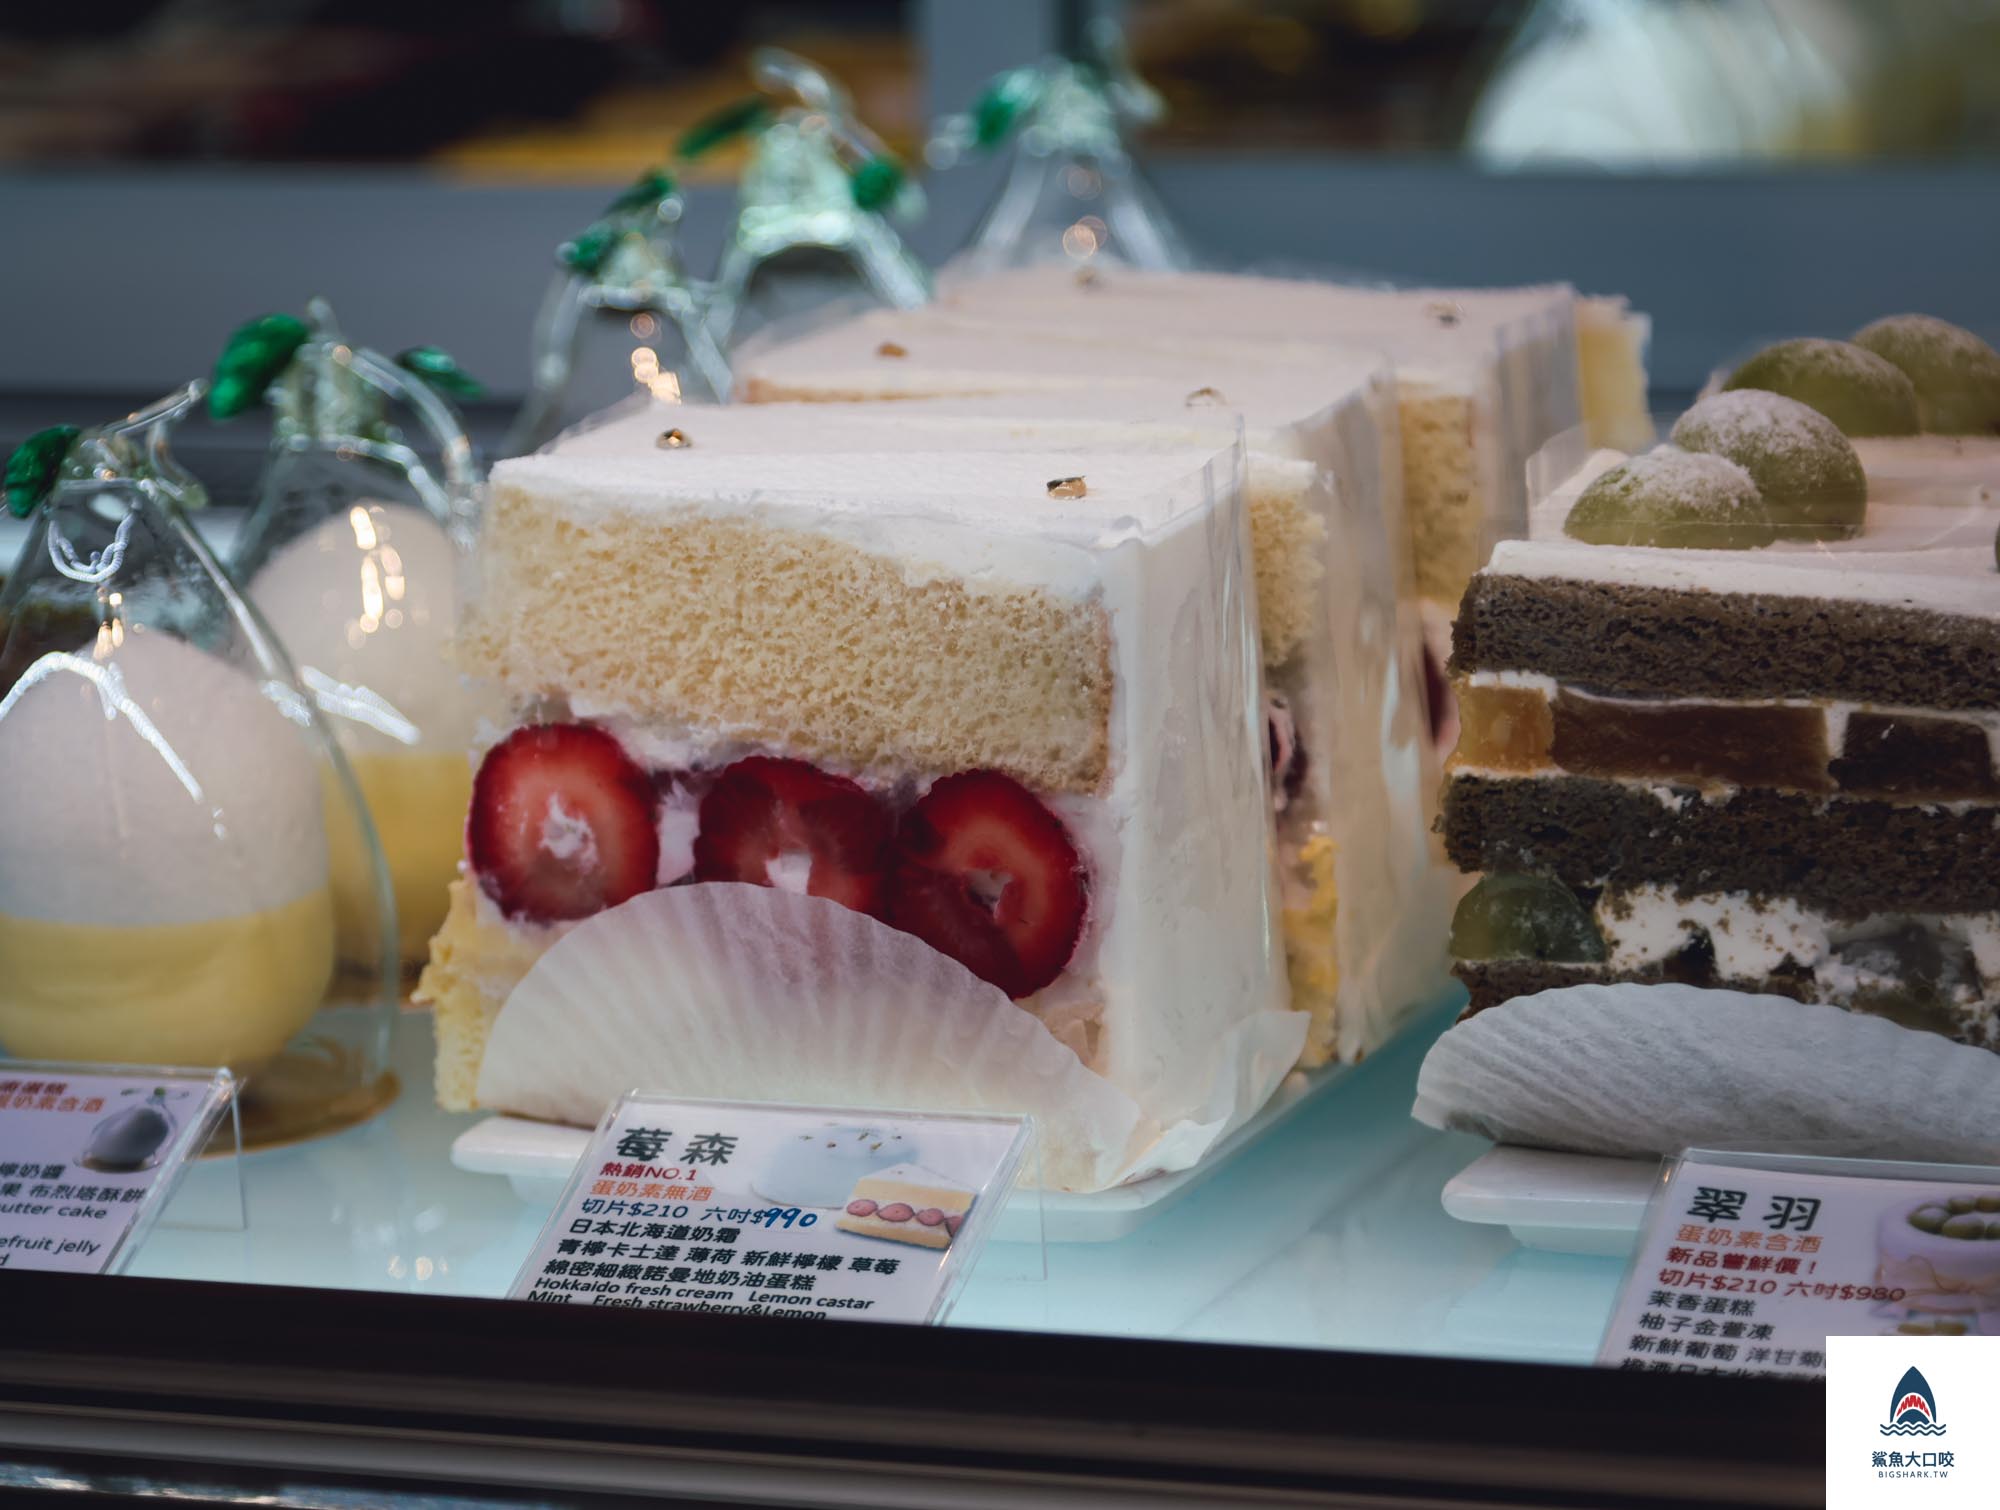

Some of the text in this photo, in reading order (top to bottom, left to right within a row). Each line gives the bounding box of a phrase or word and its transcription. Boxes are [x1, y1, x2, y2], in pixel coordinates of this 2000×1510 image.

[600, 1162, 698, 1181] 熱銷NO.1
[590, 1179, 715, 1201] 蛋奶素無酒
[0, 1202, 107, 1219] utter cake
[581, 1198, 689, 1219] 切片$210
[569, 1218, 741, 1244] 日本北海道奶霜
[1675, 1224, 1825, 1254] 蛋奶素含酒
[53, 1239, 102, 1257] jelly
[557, 1239, 902, 1275] 青檸卡士達 薄荷 新鮮檸檬 草莓
[543, 1258, 817, 1291] 綿密細緻諾曼地奶油蛋糕
[1658, 1268, 1906, 1302] 切片$210 六吋$980
[526, 1290, 572, 1304] Mint
[592, 1295, 643, 1310] Fresh
[534, 1276, 874, 1310] Hokkaido fresh cream Lemon castar
[1627, 1333, 1741, 1362] 新鮮葡萄
